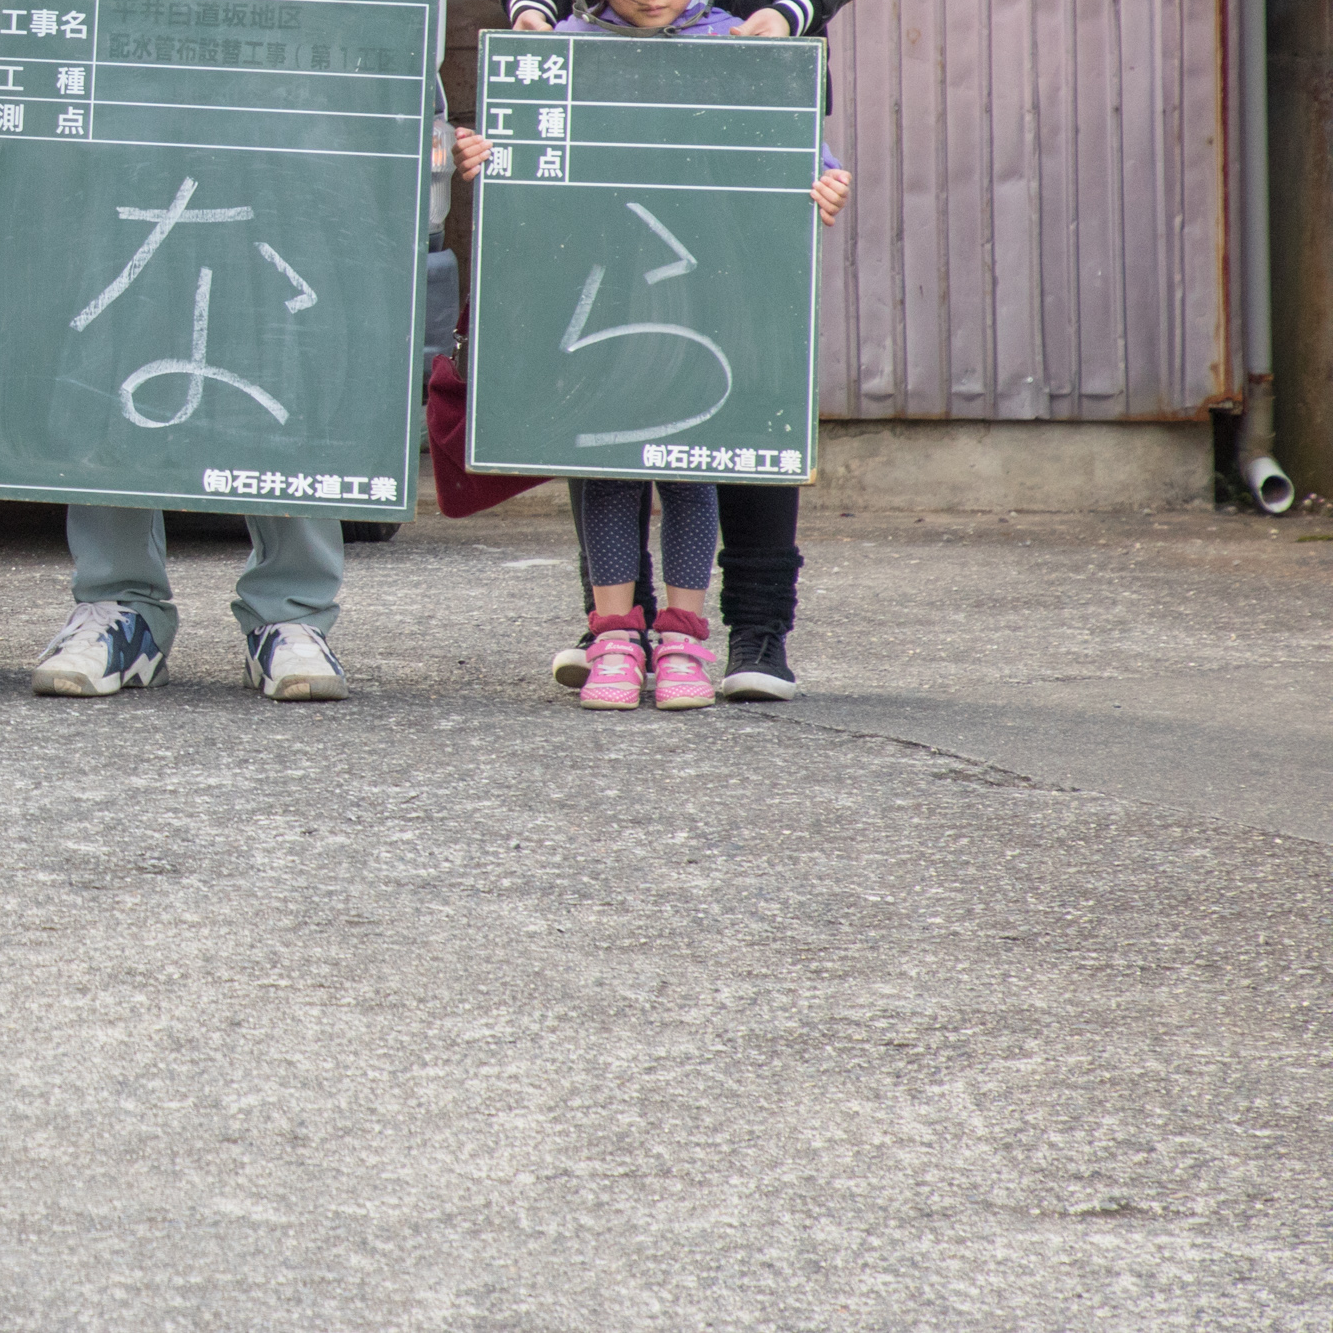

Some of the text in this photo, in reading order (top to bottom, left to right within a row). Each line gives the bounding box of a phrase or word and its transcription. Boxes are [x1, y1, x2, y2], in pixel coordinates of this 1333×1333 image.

[0, 8, 88, 41] 工事名
[489, 54, 568, 85] 工事名
[69, 176, 318, 429] な
[558, 201, 733, 449] ら
